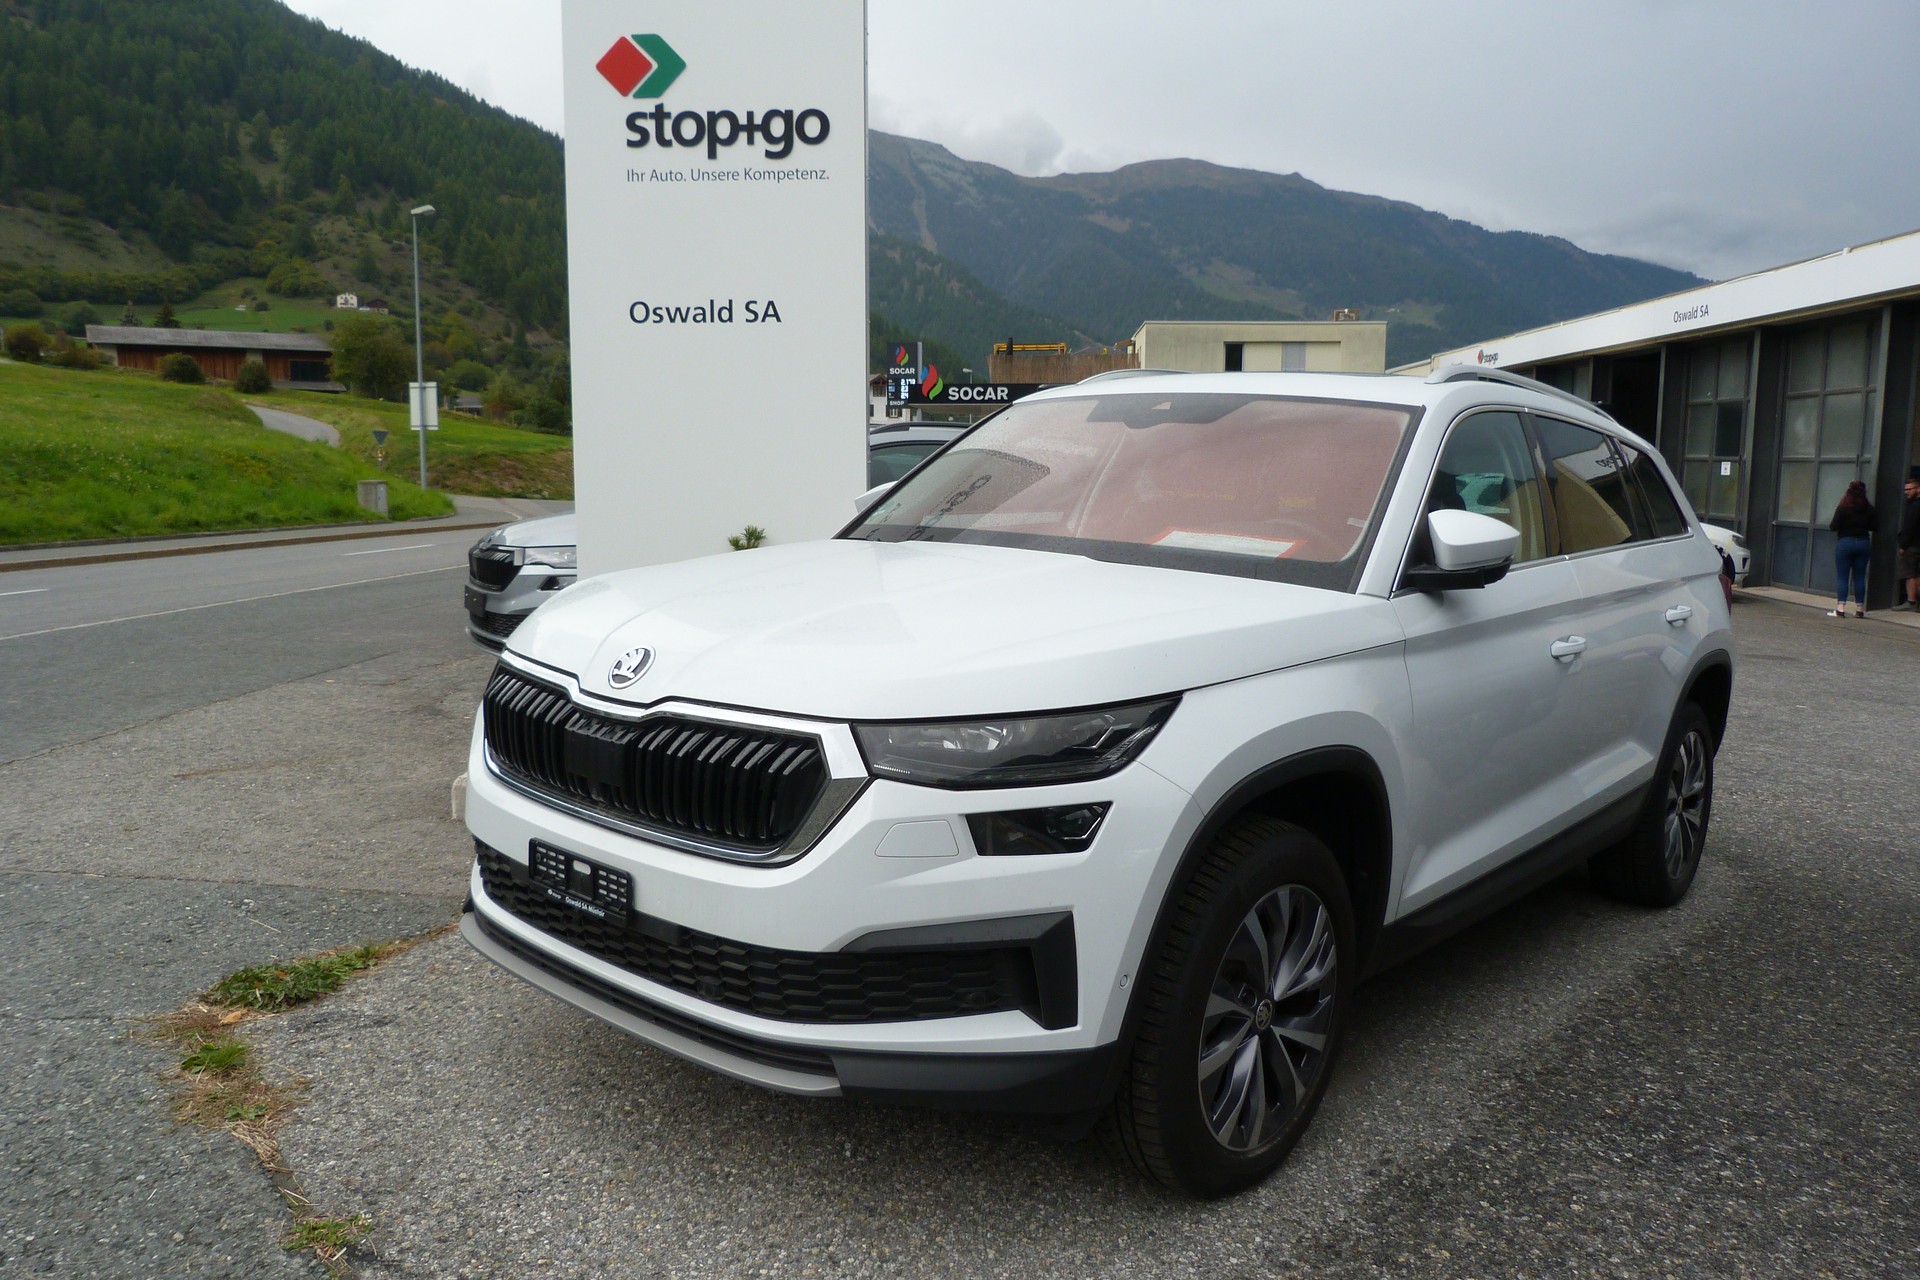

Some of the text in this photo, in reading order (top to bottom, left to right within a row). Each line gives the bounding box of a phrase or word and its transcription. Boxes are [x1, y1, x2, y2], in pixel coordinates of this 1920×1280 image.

[625, 102, 830, 160] stop+go
[626, 167, 830, 184] Ihr Auto. Unsere Kompetenz.
[629, 299, 782, 324] Oswald SA
[1673, 304, 1709, 323] Oswald SA
[889, 367, 915, 375] SOCAR
[948, 386, 1009, 401] SOCAR
